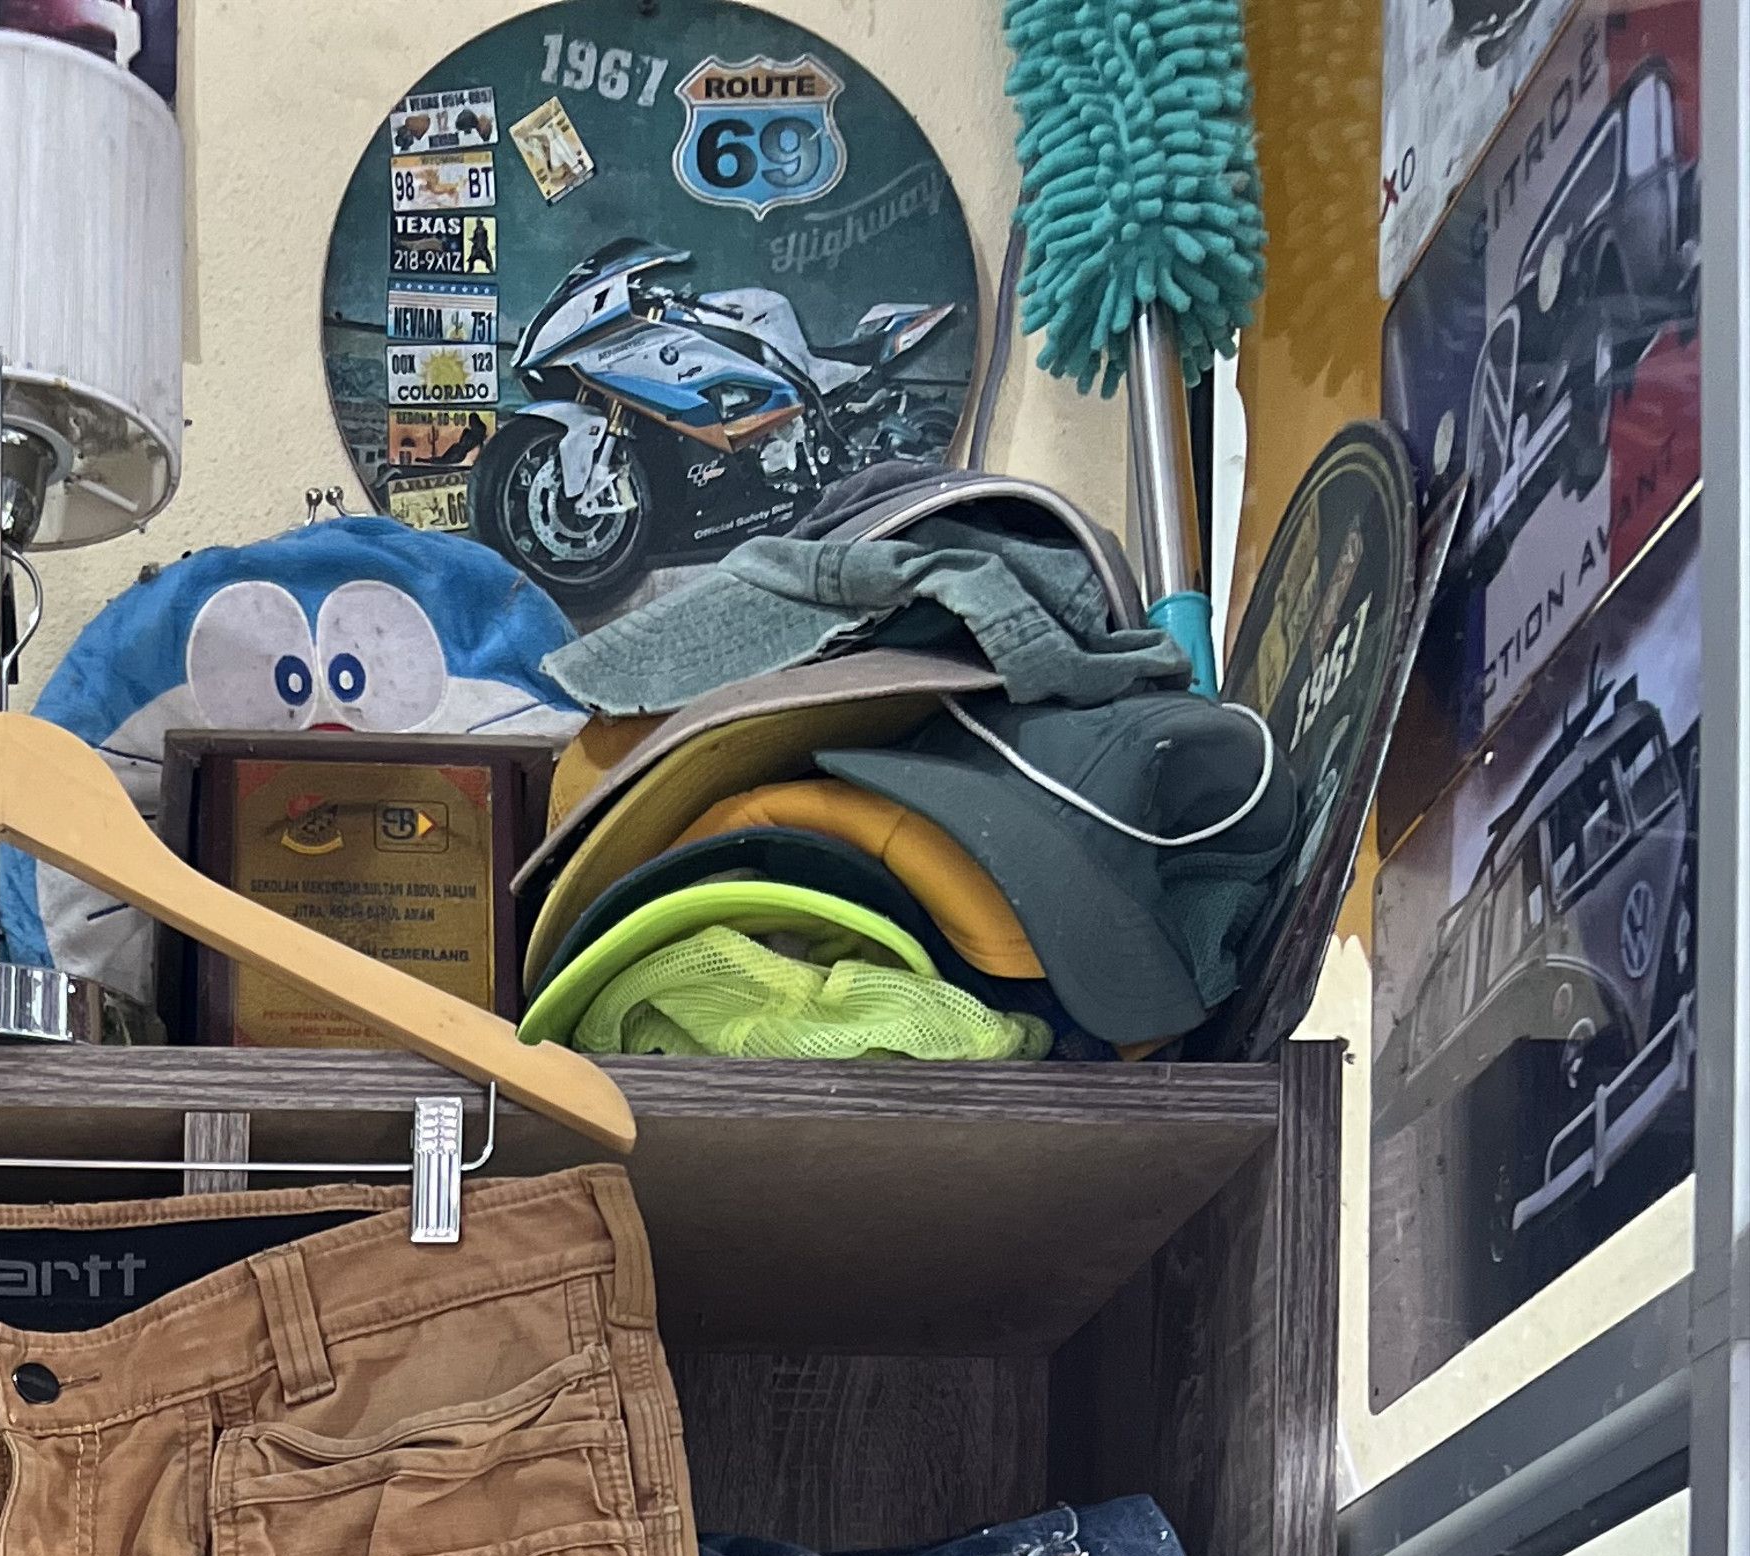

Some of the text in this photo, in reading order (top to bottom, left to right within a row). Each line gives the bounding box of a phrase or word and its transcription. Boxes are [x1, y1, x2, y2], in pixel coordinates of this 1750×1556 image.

[540, 33, 669, 107] 1967
[704, 75, 816, 99] ROUTE
[696, 115, 822, 189] 69
[394, 166, 493, 201] 98 BT
[394, 215, 462, 235] TEXAS
[769, 165, 945, 273] Highway
[592, 287, 611, 314] 1
[394, 306, 493, 343] NEVADA 751
[472, 351, 494, 373] 123
[397, 382, 490, 401] COLORADO
[381, 947, 471, 963] CEMERLANG
